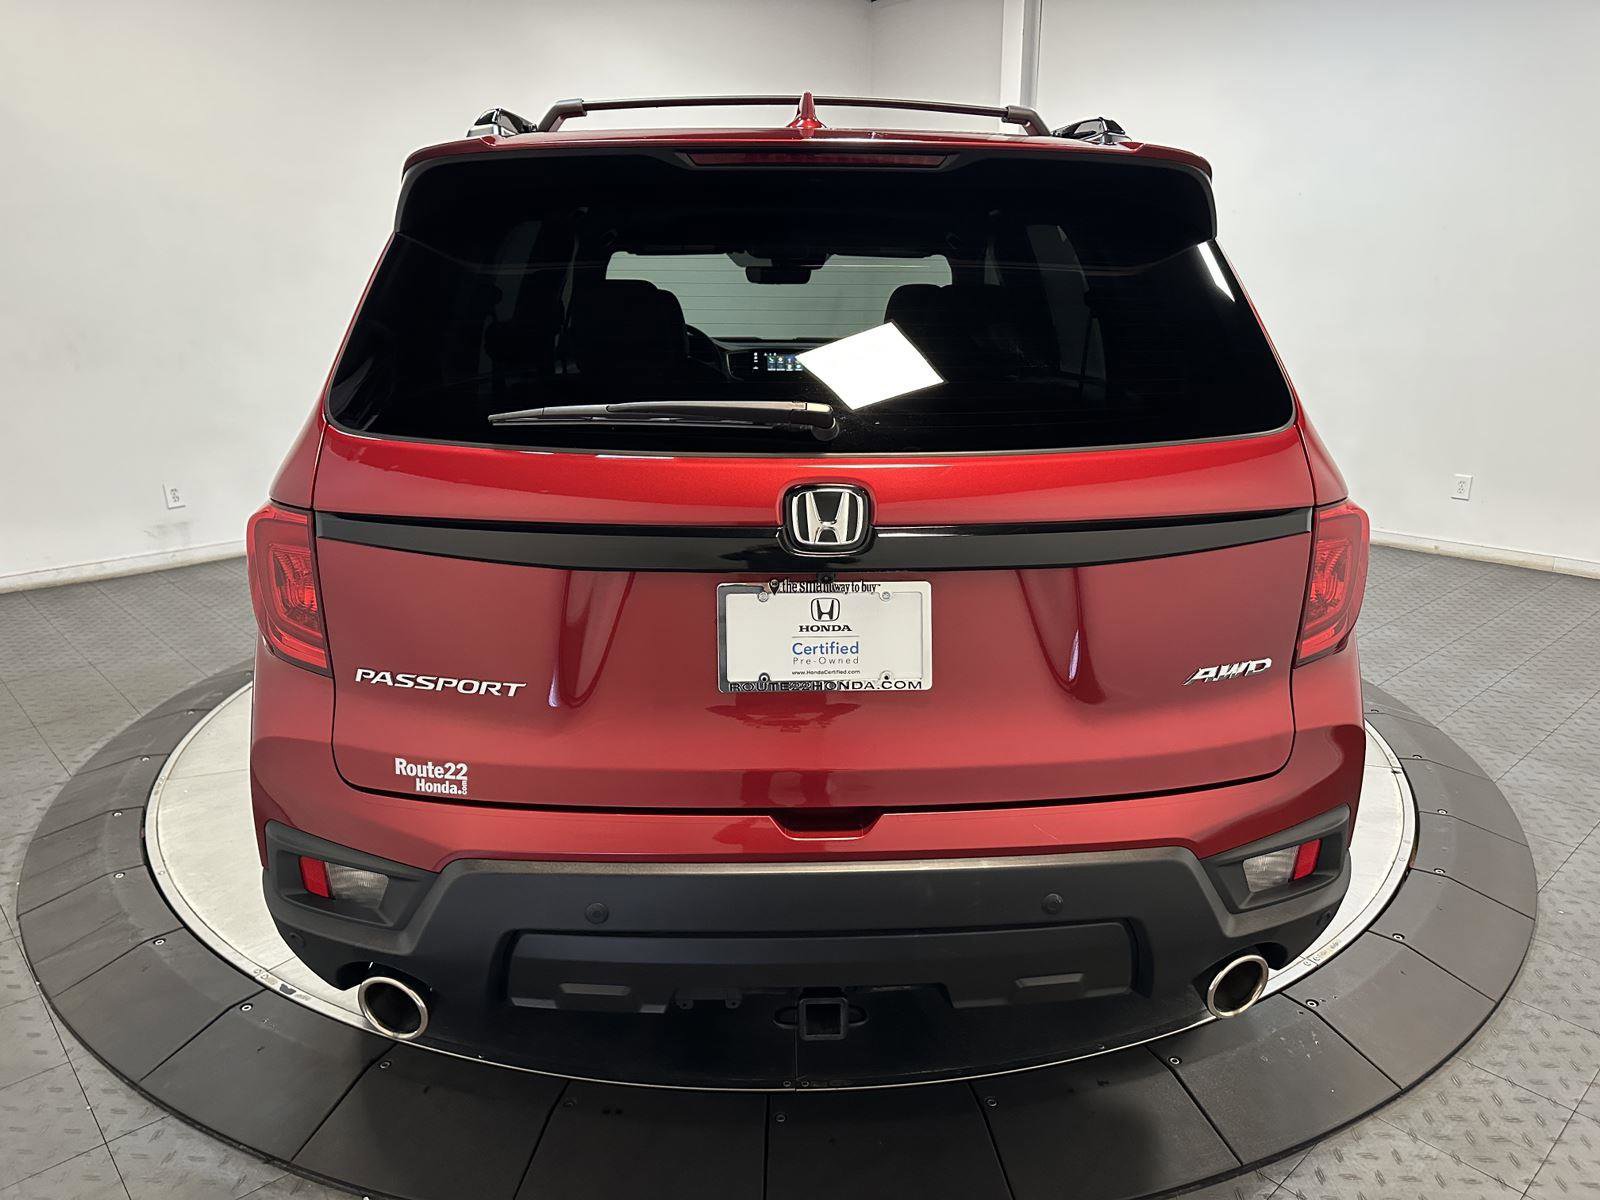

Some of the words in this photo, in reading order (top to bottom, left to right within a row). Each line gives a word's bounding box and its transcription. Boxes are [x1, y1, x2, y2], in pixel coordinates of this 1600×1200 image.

[782, 580, 798, 593] the
[851, 582, 860, 593] to
[798, 624, 852, 632] HONDA
[792, 642, 859, 655] Certified
[792, 656, 859, 665] Pre-Owned
[1181, 658, 1272, 686] AWD
[355, 668, 527, 697] PASSPORT
[394, 757, 468, 780] Route22
